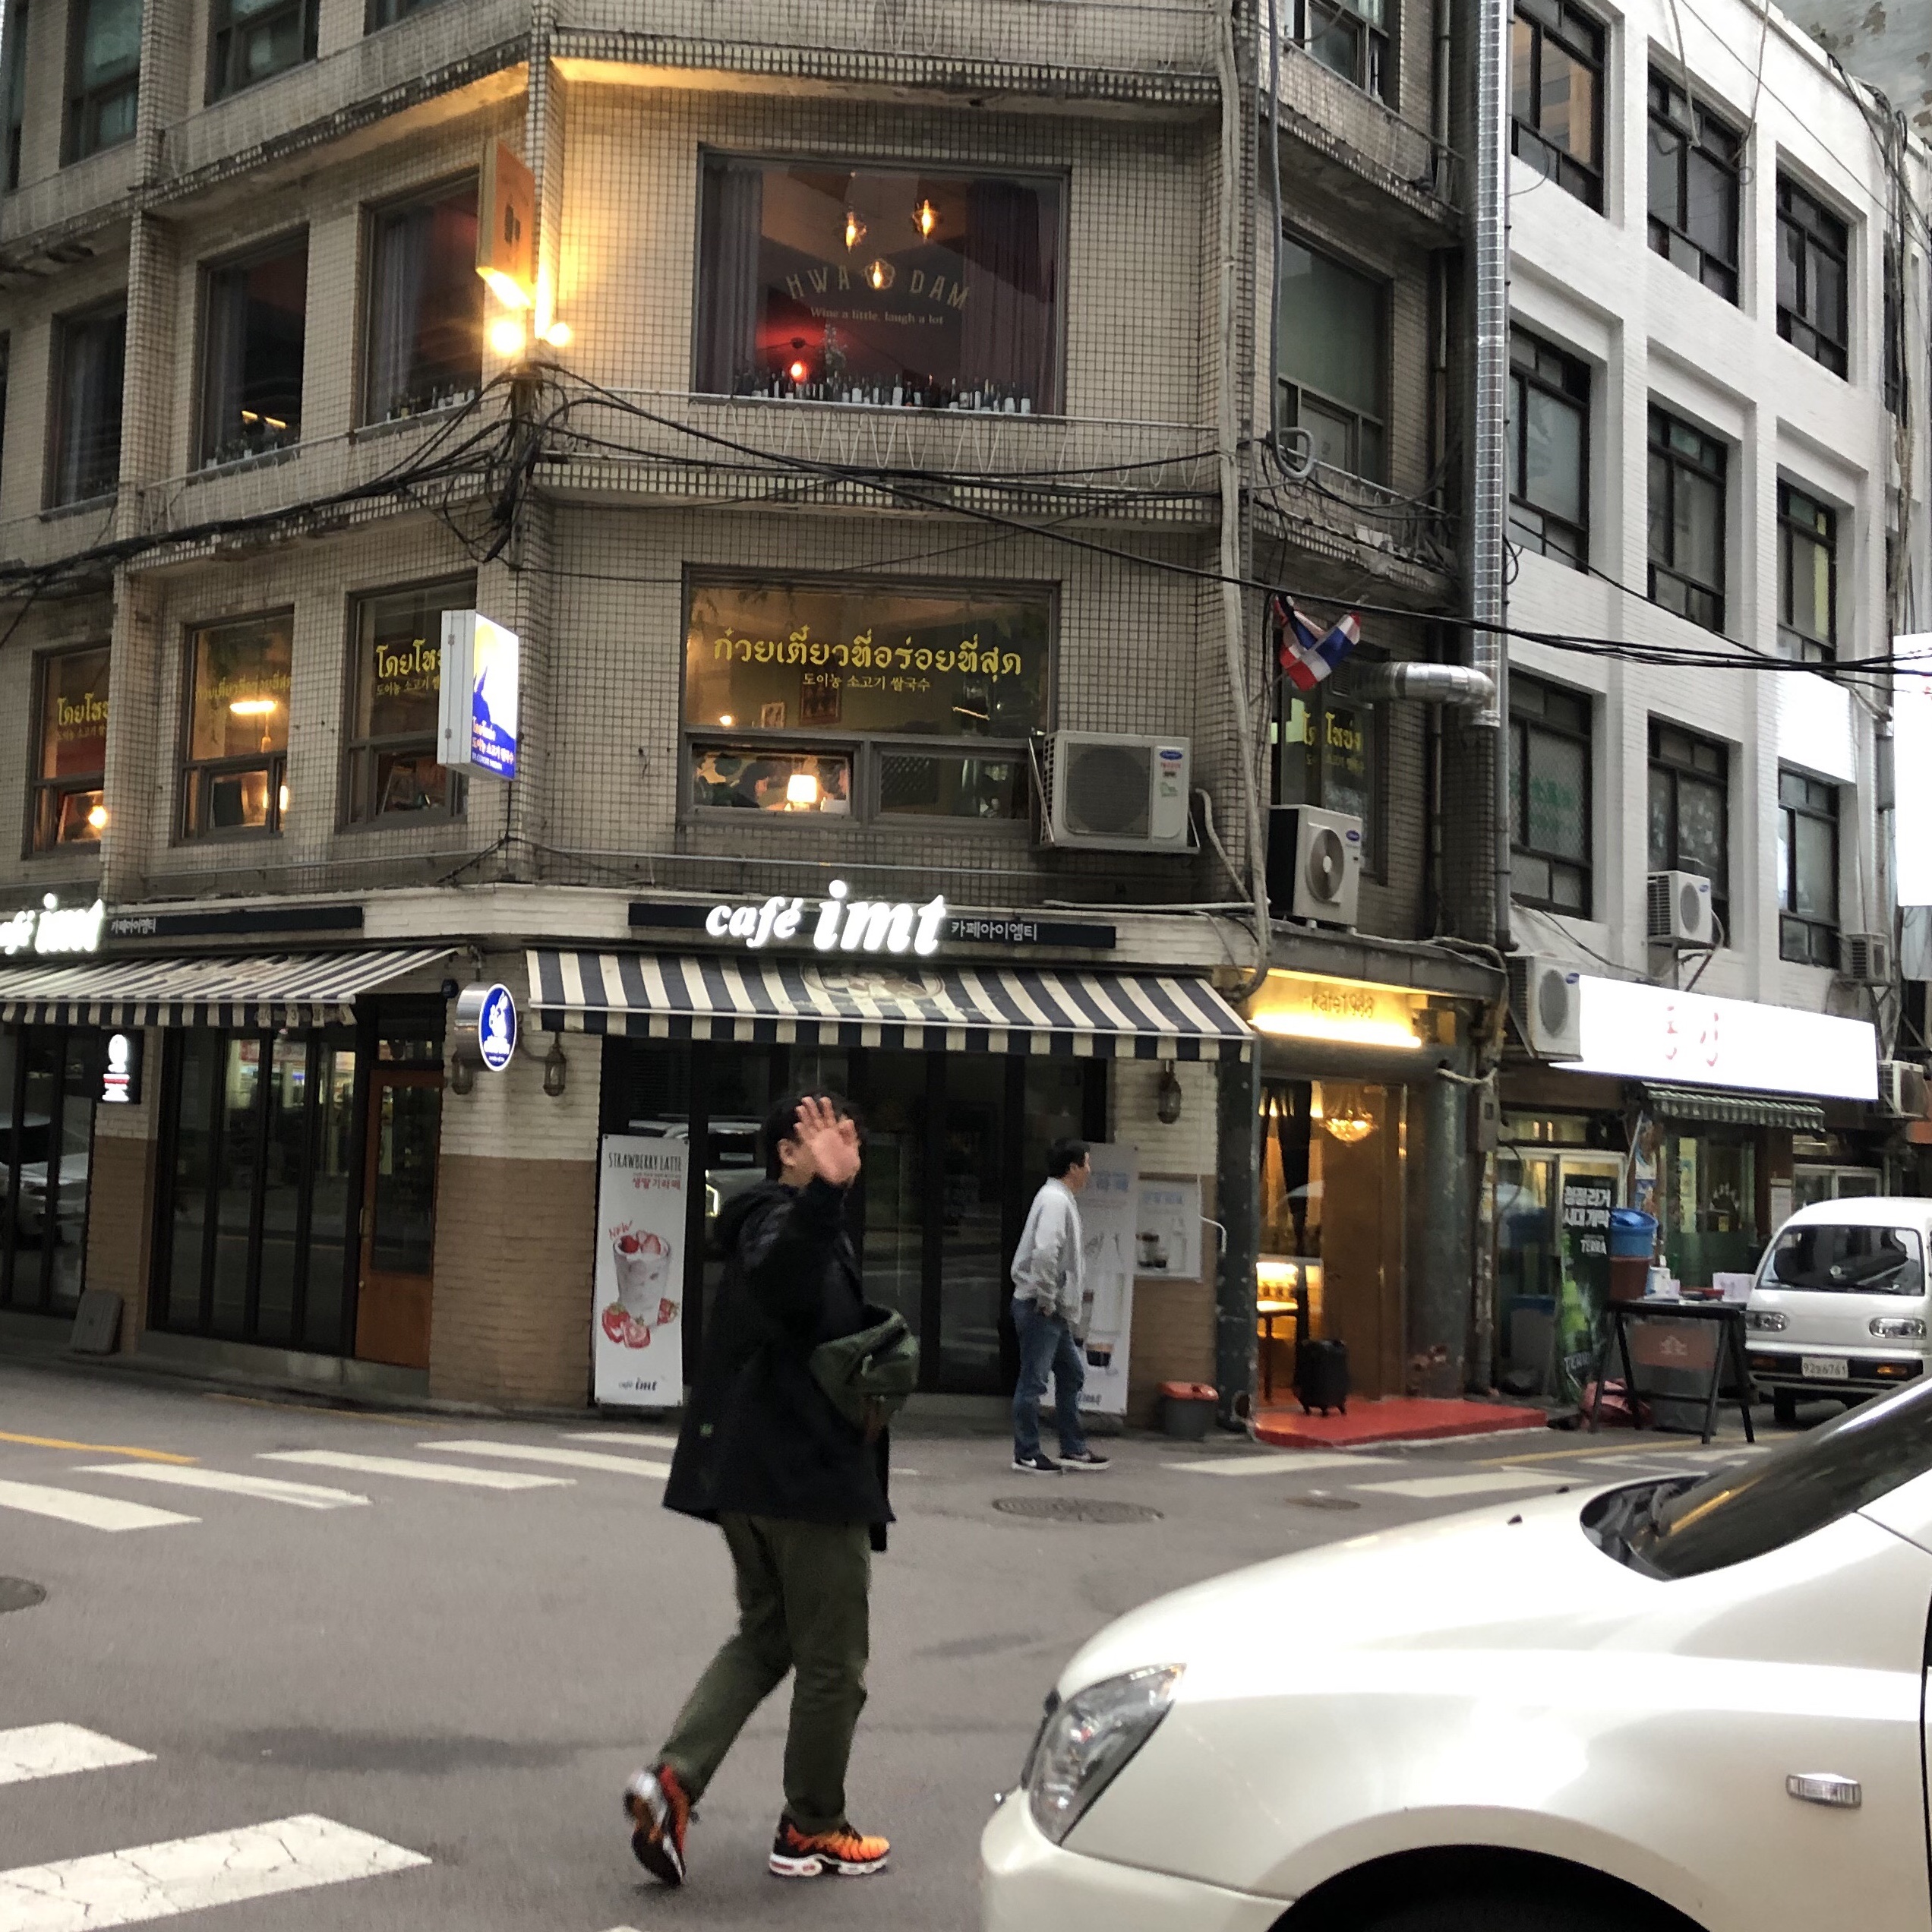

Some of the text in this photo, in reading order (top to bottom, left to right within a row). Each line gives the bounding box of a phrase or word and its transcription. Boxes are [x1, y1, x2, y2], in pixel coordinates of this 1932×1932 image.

[785, 266, 970, 310] HWA DAM
[810, 306, 838, 317] Wine
[884, 312, 916, 325] laugh
[928, 314, 943, 325] lot
[803, 672, 930, 693] 도이농 소고기 쌀국수
[706, 880, 946, 955] café imt
[951, 920, 1037, 942] 카페아이엠티
[608, 1151, 658, 1170] STRAWBERRY
